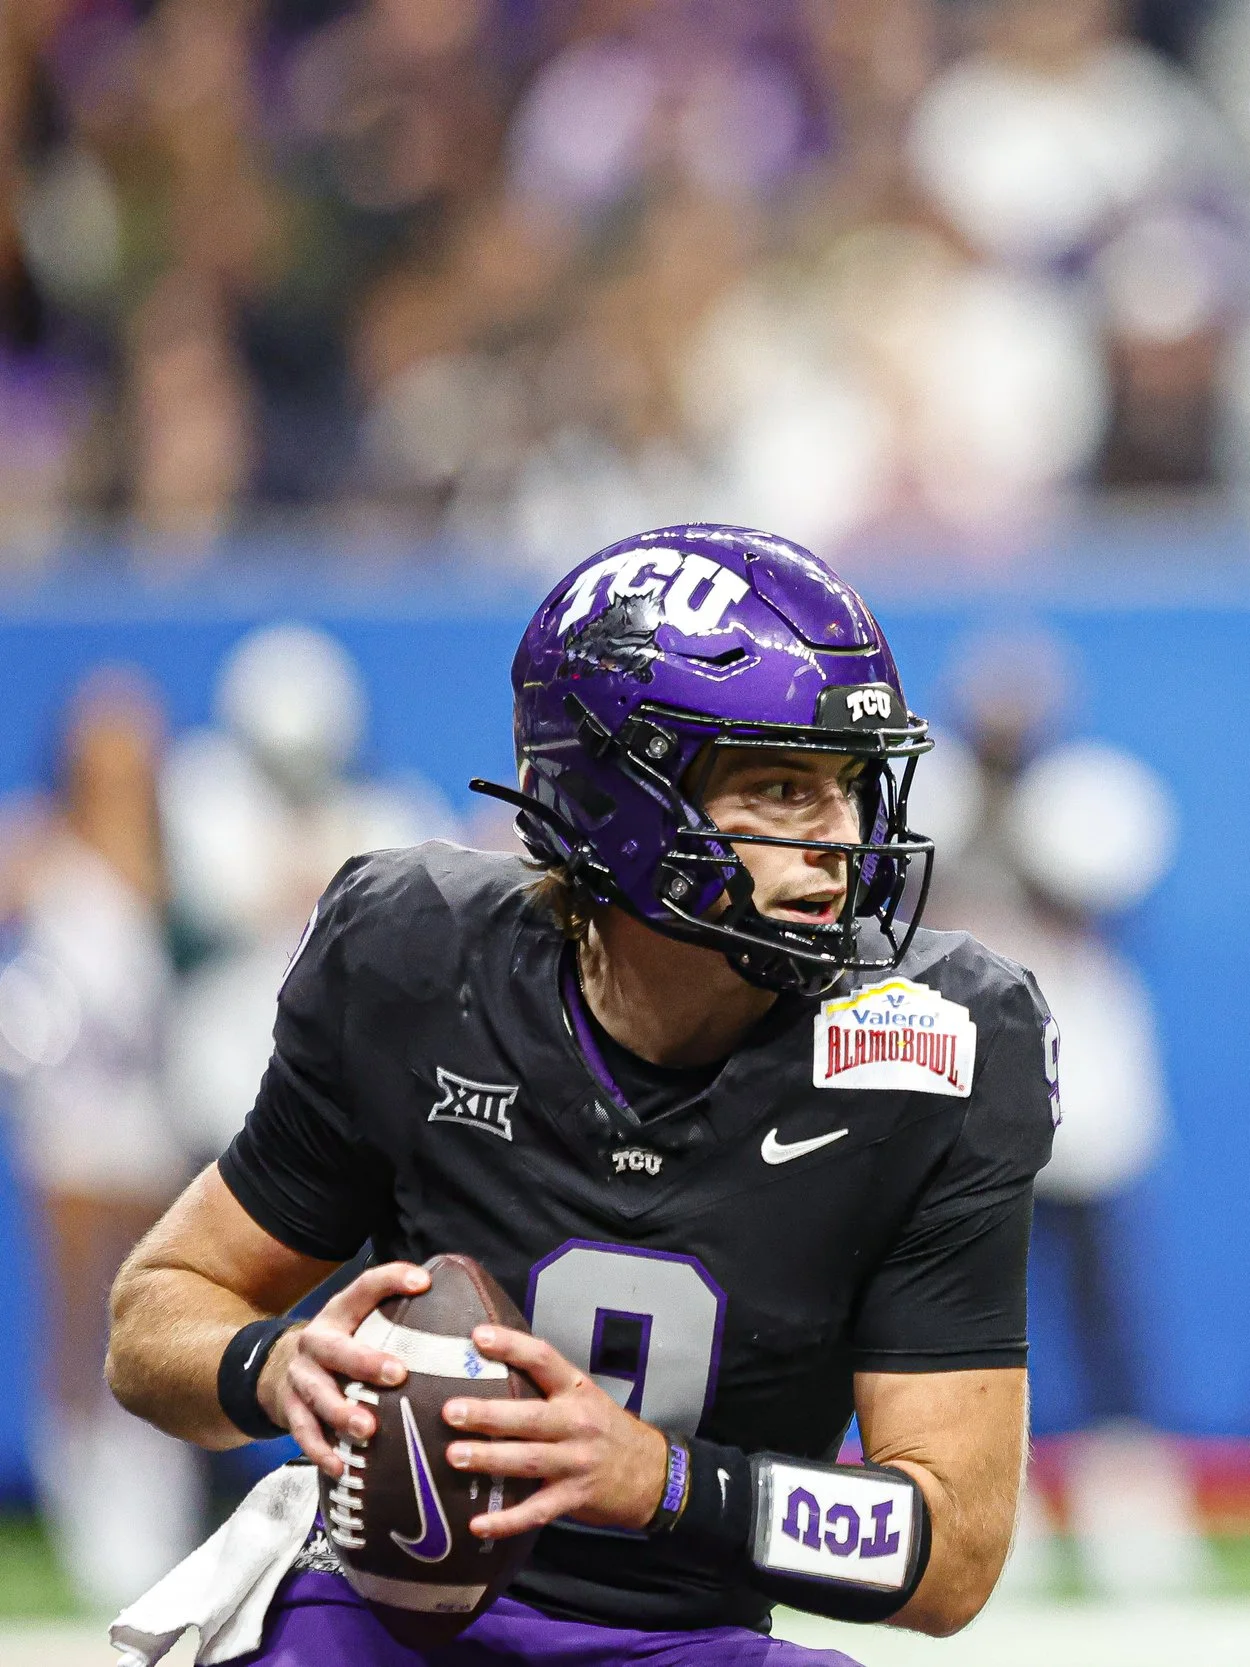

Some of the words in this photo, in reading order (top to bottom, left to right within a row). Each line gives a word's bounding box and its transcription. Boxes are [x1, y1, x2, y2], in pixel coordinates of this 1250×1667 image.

[557, 547, 751, 637] TCU
[846, 689, 891, 722] TCU
[852, 1009, 935, 1028] Valero
[612, 1150, 663, 1176] TCU
[524, 1237, 728, 1437] 9
[781, 1486, 901, 1560] TCU
